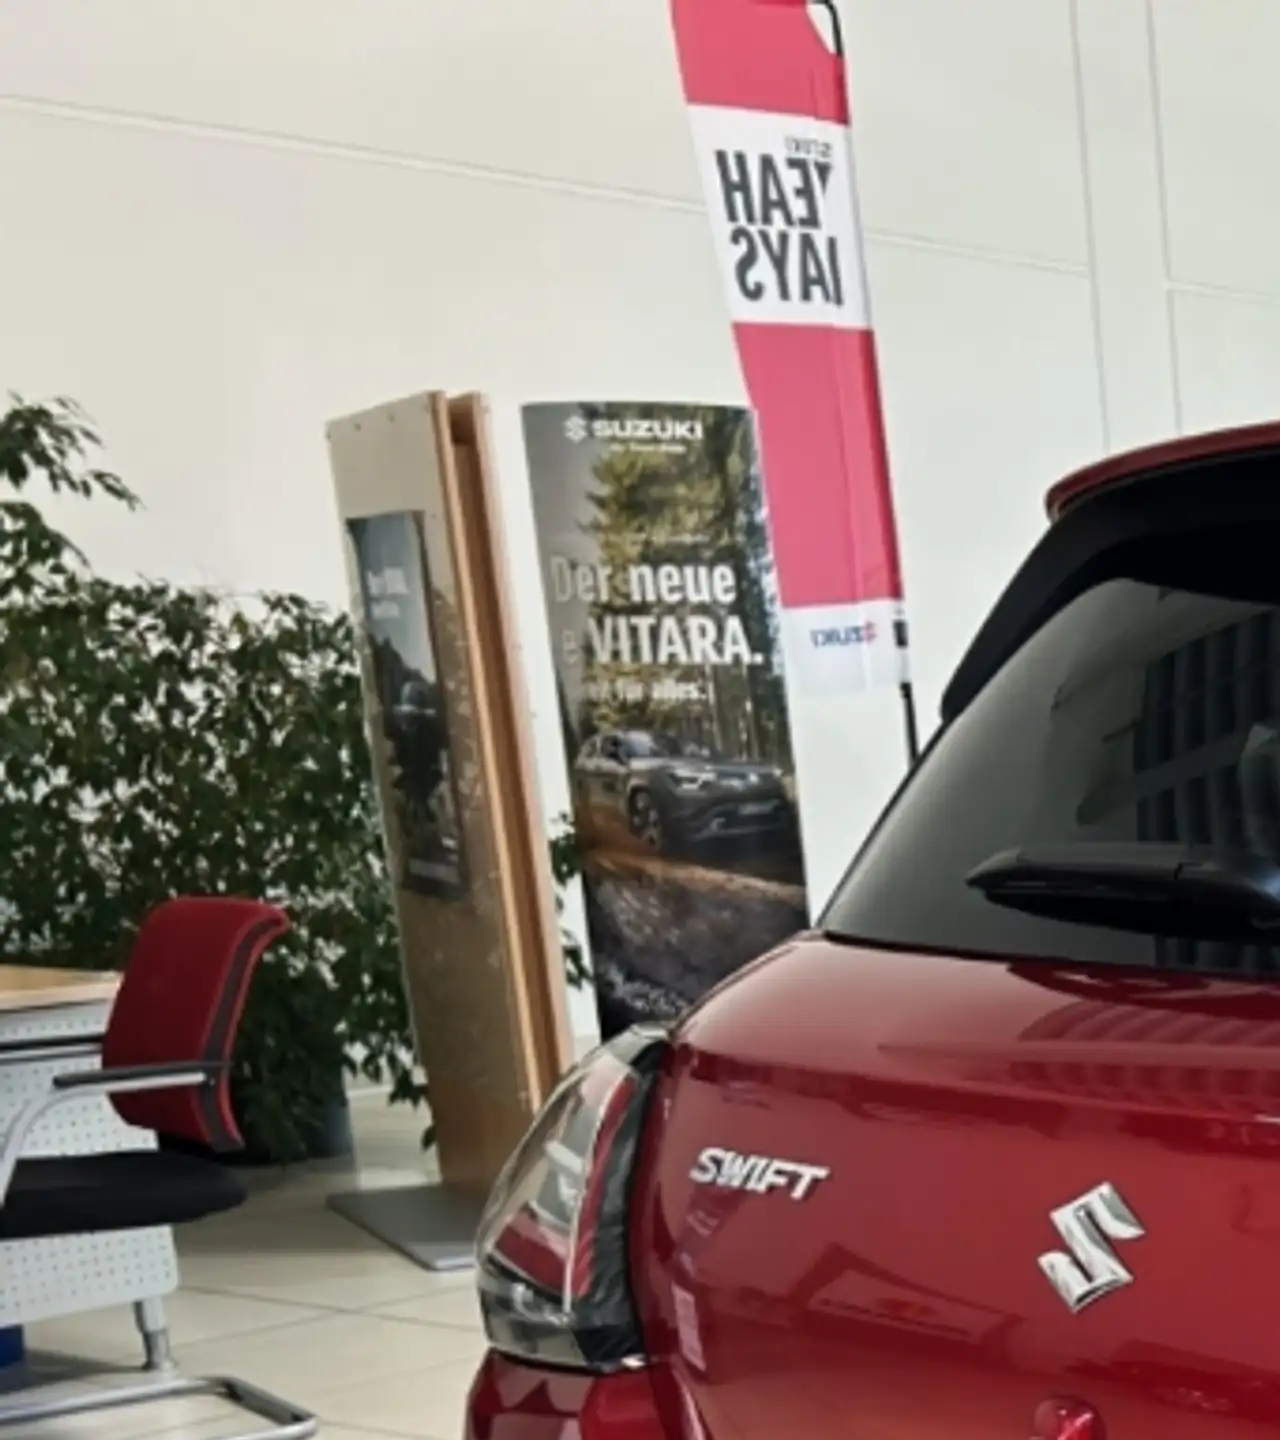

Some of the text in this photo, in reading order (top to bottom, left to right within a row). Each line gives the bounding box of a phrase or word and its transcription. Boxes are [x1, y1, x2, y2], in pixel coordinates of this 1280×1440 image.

[592, 420, 704, 439] SUZUKI
[551, 556, 737, 605] Der neue
[587, 614, 764, 665] VITARA.
[689, 1146, 831, 1200] SWIFT
